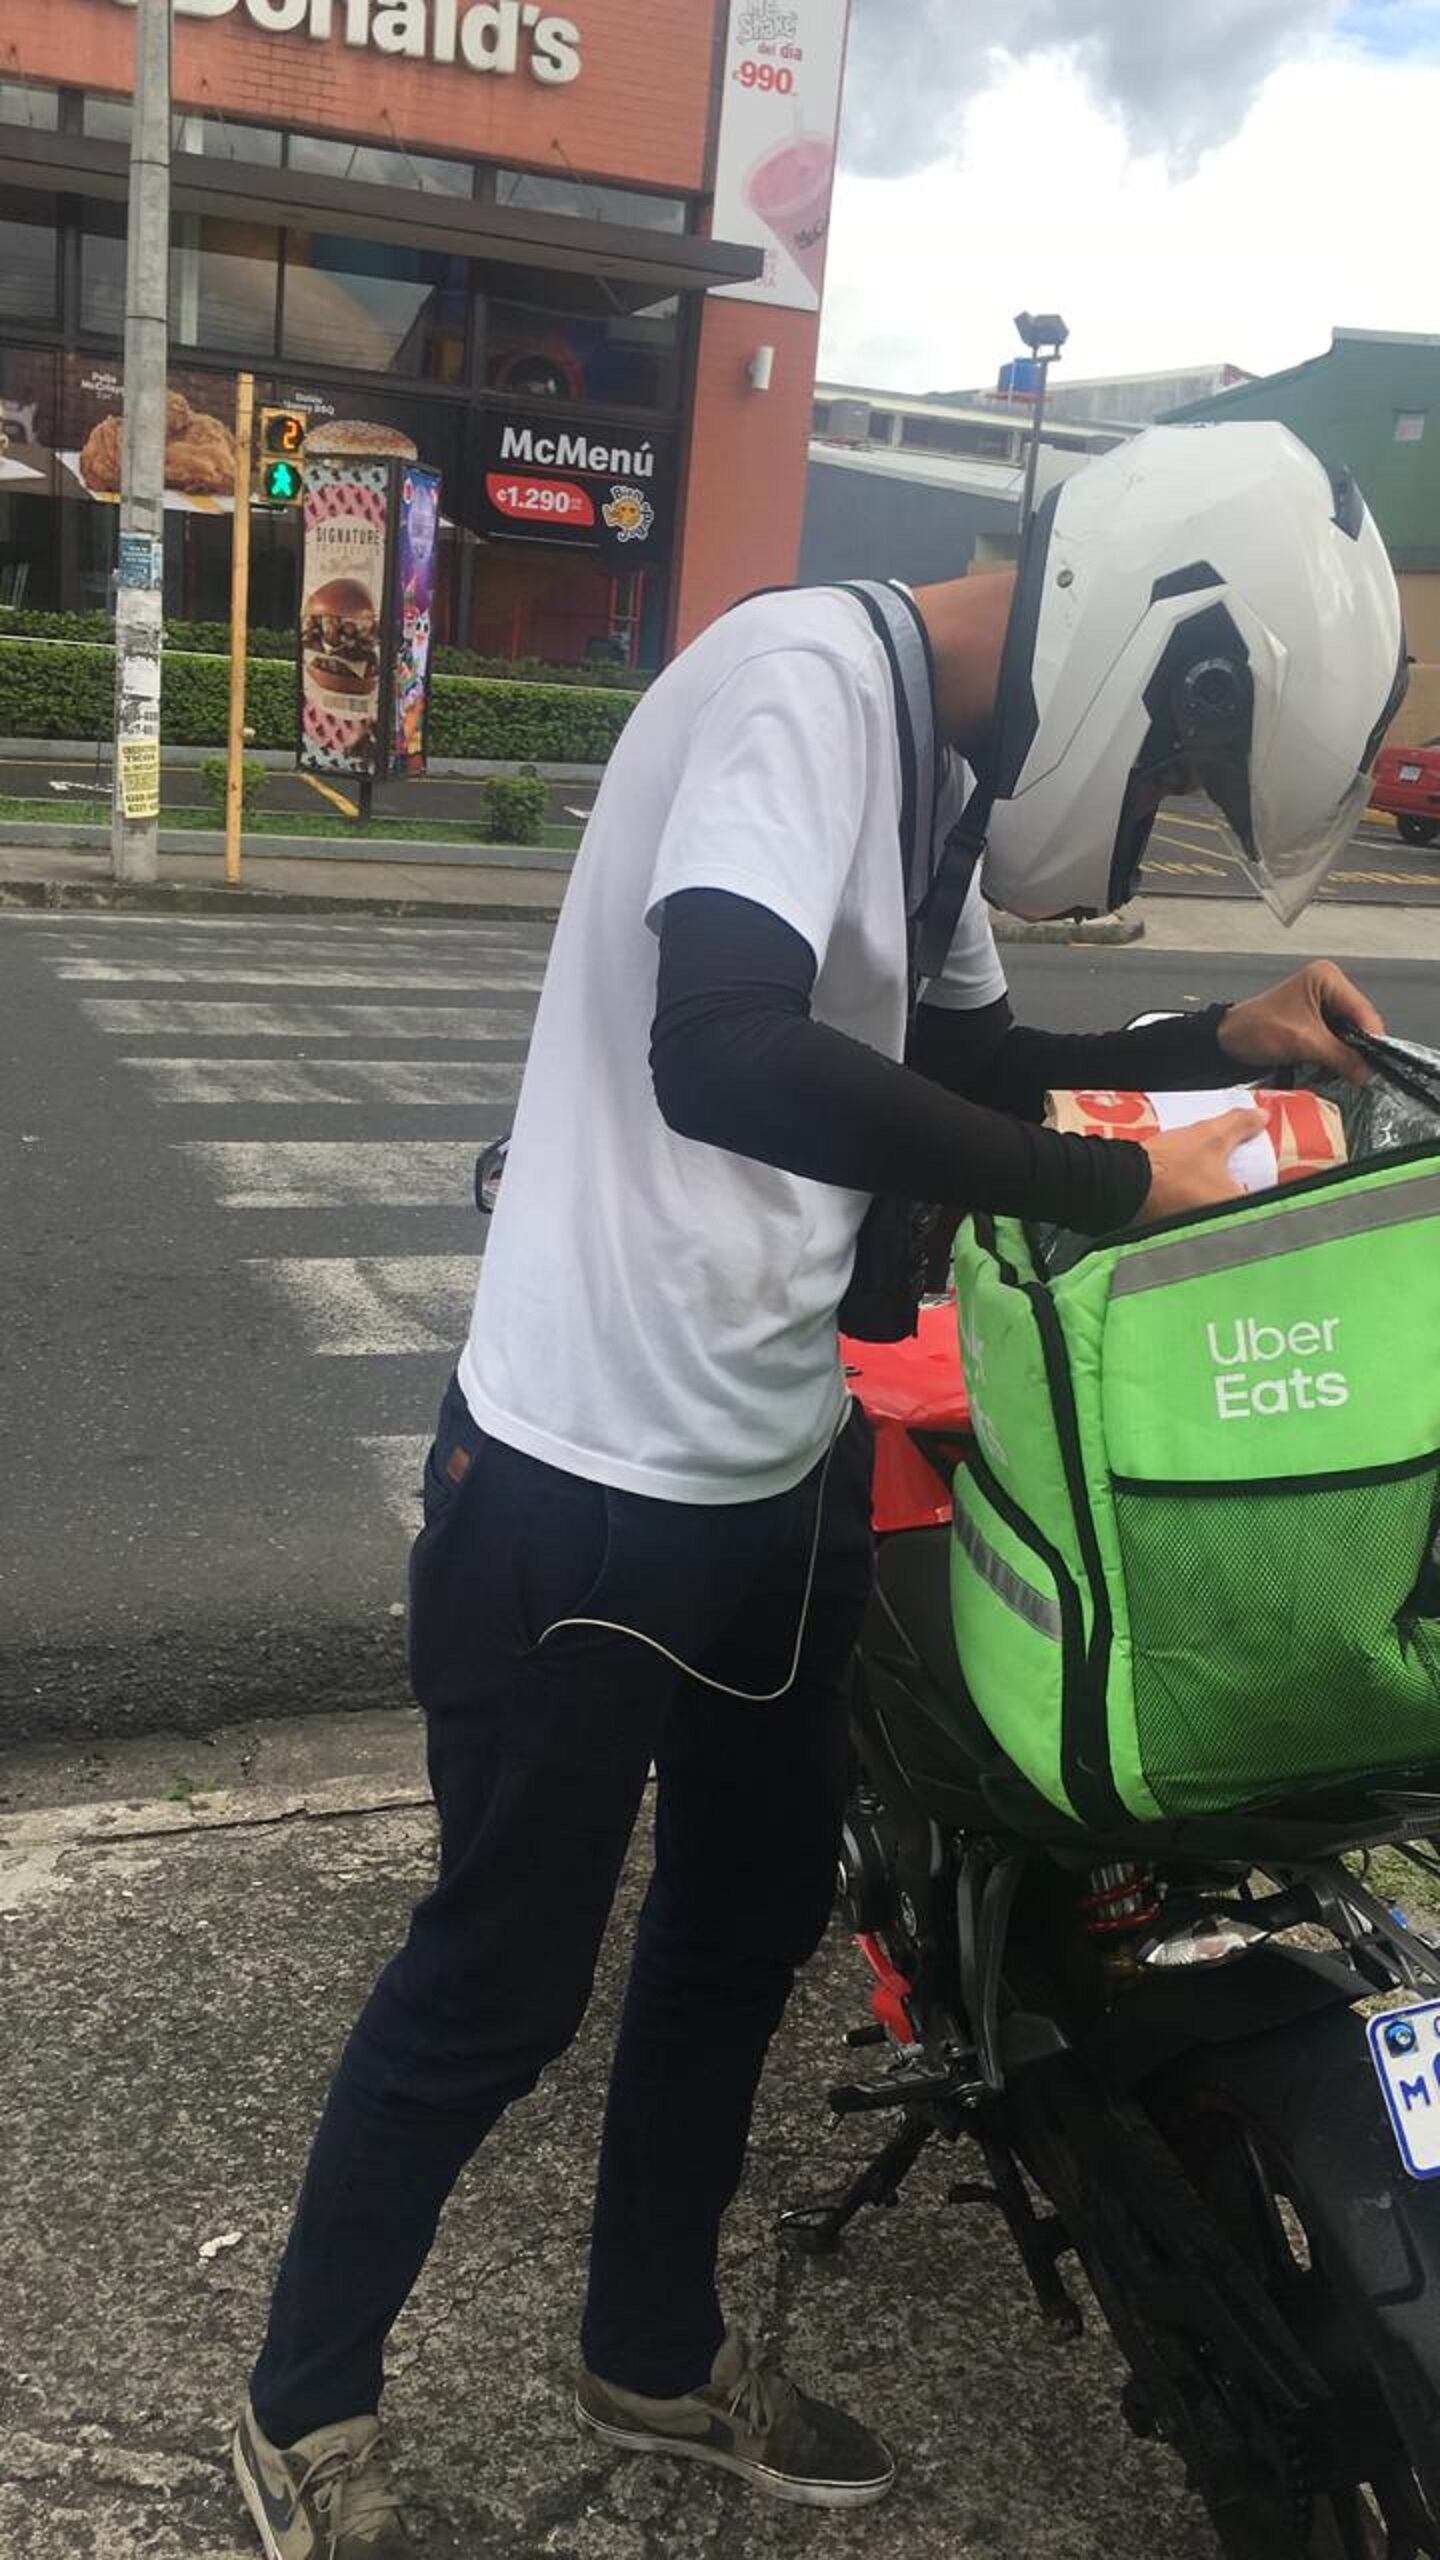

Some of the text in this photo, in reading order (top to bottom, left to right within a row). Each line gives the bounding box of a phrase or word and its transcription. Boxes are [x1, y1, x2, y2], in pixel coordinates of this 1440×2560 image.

[114, 0, 582, 86] onald's
[282, 422, 298, 449] 2
[500, 427, 654, 477] McMenú
[1206, 1316, 1340, 1366] Uber
[1214, 1368, 1350, 1419] Eats
